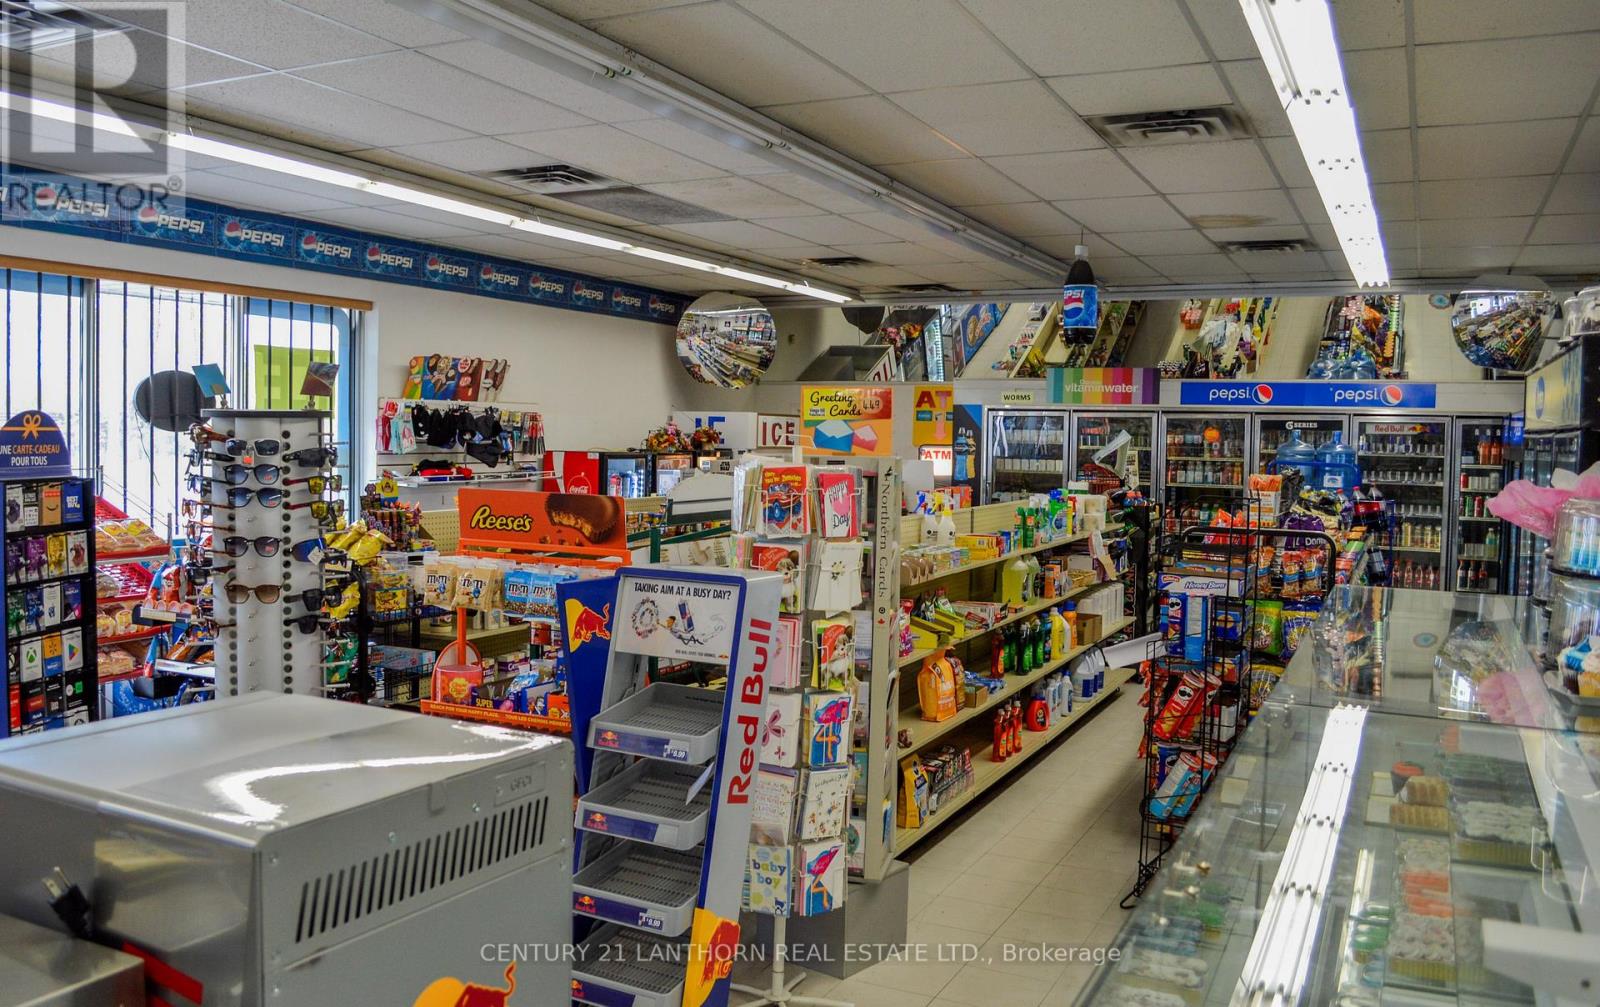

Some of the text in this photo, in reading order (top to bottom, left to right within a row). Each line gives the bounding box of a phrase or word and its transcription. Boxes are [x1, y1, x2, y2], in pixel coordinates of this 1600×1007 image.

[56, 198, 110, 218] PEPSI
[157, 214, 204, 234] PEPSI
[240, 229, 285, 247] PEPSI
[316, 241, 352, 259] PEPSI
[380, 253, 413, 269] PEPSI
[439, 263, 469, 278] PEPSI
[491, 271, 519, 286] PEPSI
[539, 280, 564, 295] PEPSI
[581, 288, 604, 301] PEPSI
[620, 293, 641, 307] PEPSI
[655, 301, 675, 313] PEPSI
[1065, 383, 1139, 393] vitaminwater
[1209, 387, 1249, 401] pepsi
[1334, 388, 1377, 402] pepsi
[810, 391, 853, 407] Greeting
[862, 399, 880, 410] 4.49
[829, 404, 862, 417] Cards
[762, 421, 795, 446] ICE
[13, 444, 60, 454] CARTE-CADEAU
[924, 450, 952, 460] ATM
[11, 456, 48, 466] POUR TOUS
[470, 505, 533, 532] Reese's
[831, 514, 849, 529] Day
[878, 484, 891, 598] Northern Cards
[634, 582, 732, 600] TAKING AIM AT A BUSY DAY?
[1184, 581, 1226, 590] Honey Buns
[476, 698, 493, 709] SUPER
[727, 618, 772, 804] Red Bull
[752, 859, 786, 877] baby
[757, 873, 781, 889] boy
